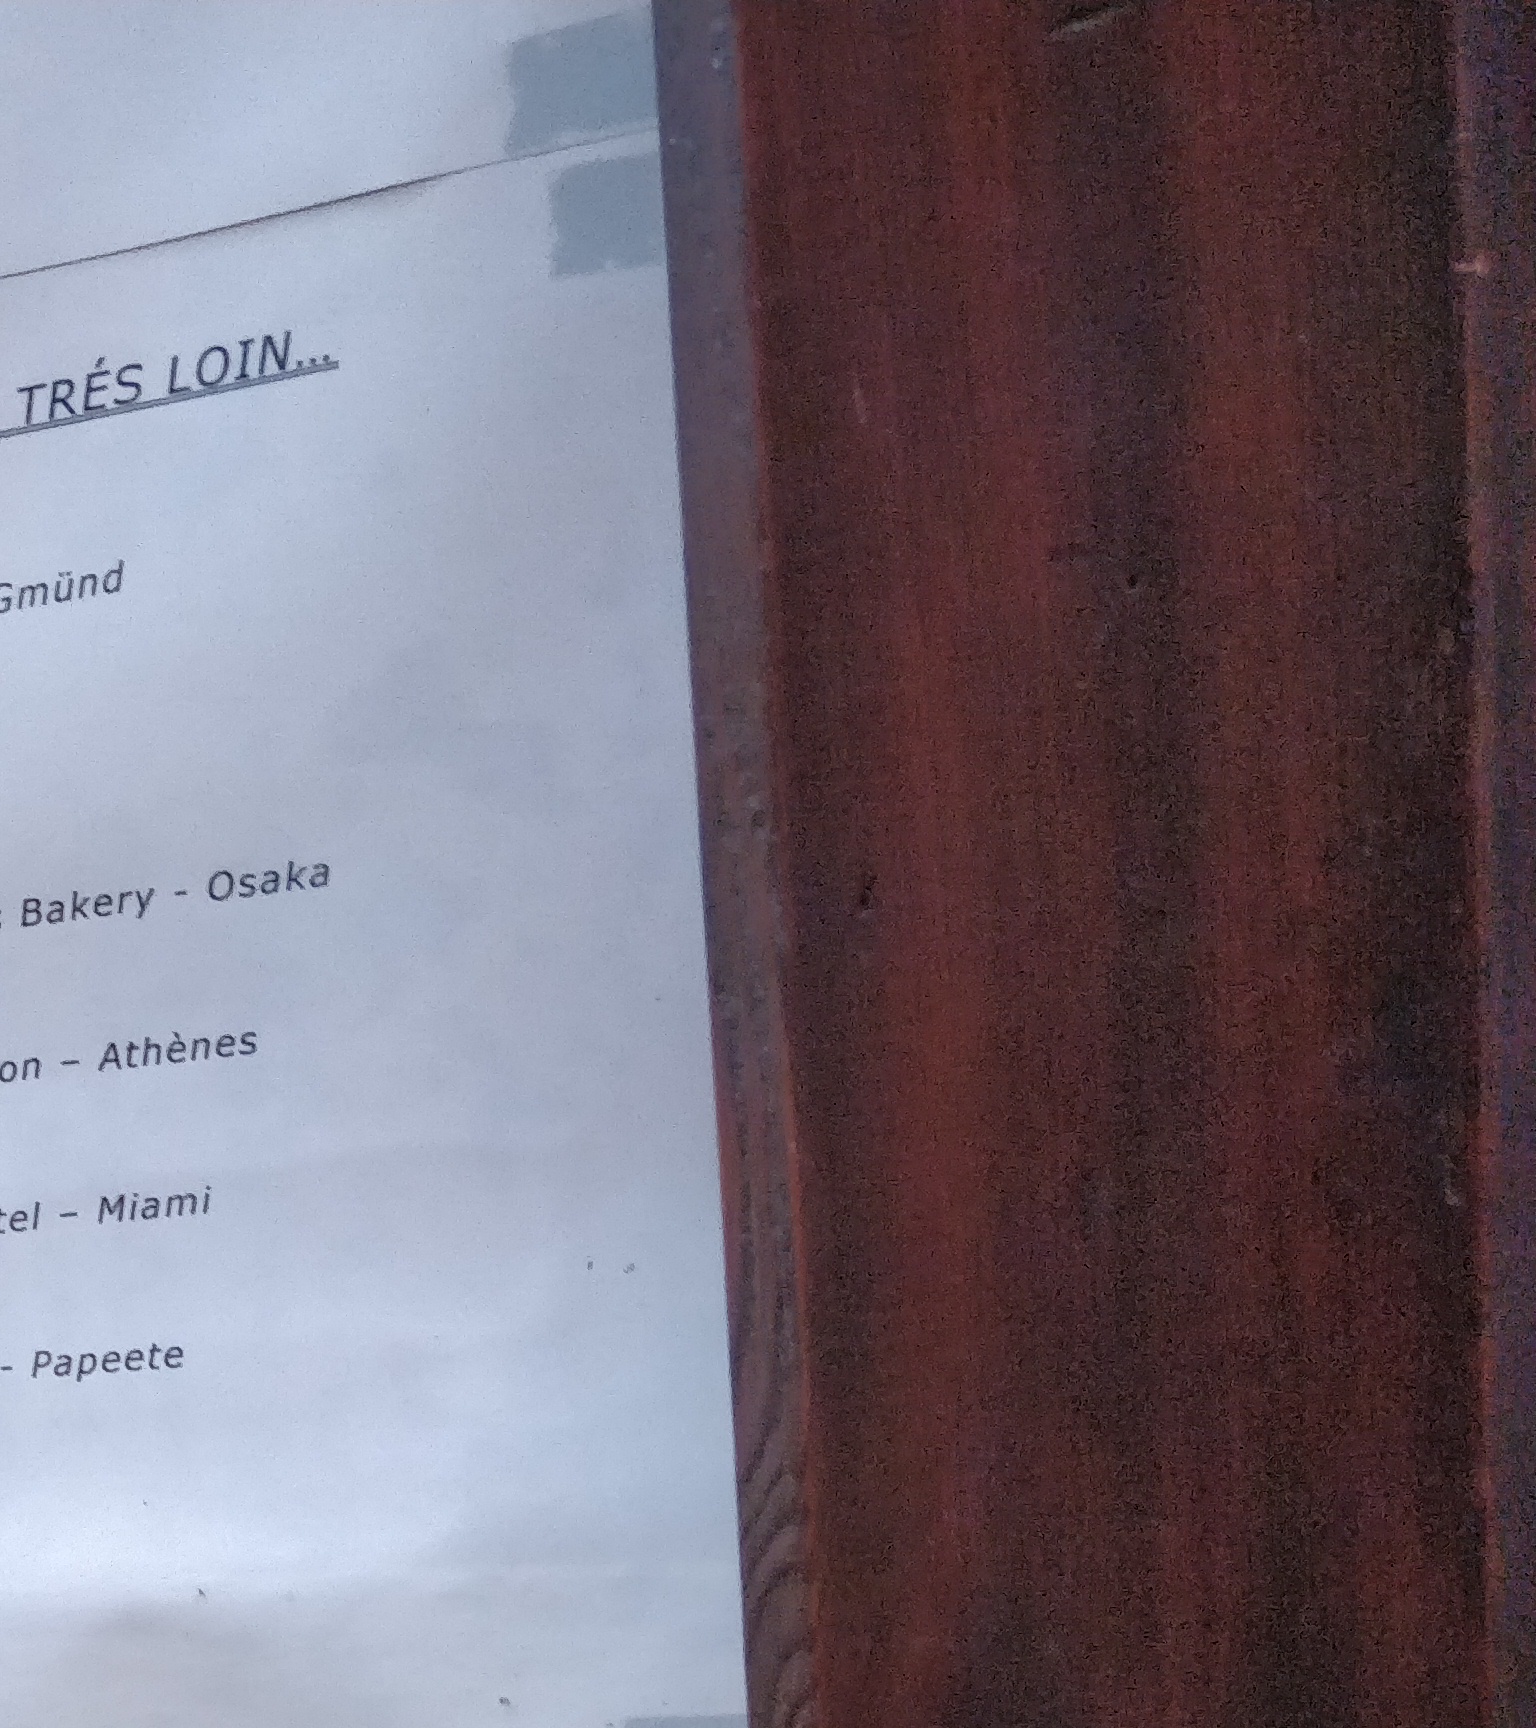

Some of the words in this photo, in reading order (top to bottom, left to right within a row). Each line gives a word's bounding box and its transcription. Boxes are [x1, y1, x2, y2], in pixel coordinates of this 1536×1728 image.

[16, 357, 144, 427] TRÉS
[20, 881, 157, 927] Bakery
[207, 860, 330, 902] Osaka
[98, 1026, 258, 1072] Athènes
[98, 1185, 213, 1224] Miami
[31, 1342, 185, 1382] Papeete
